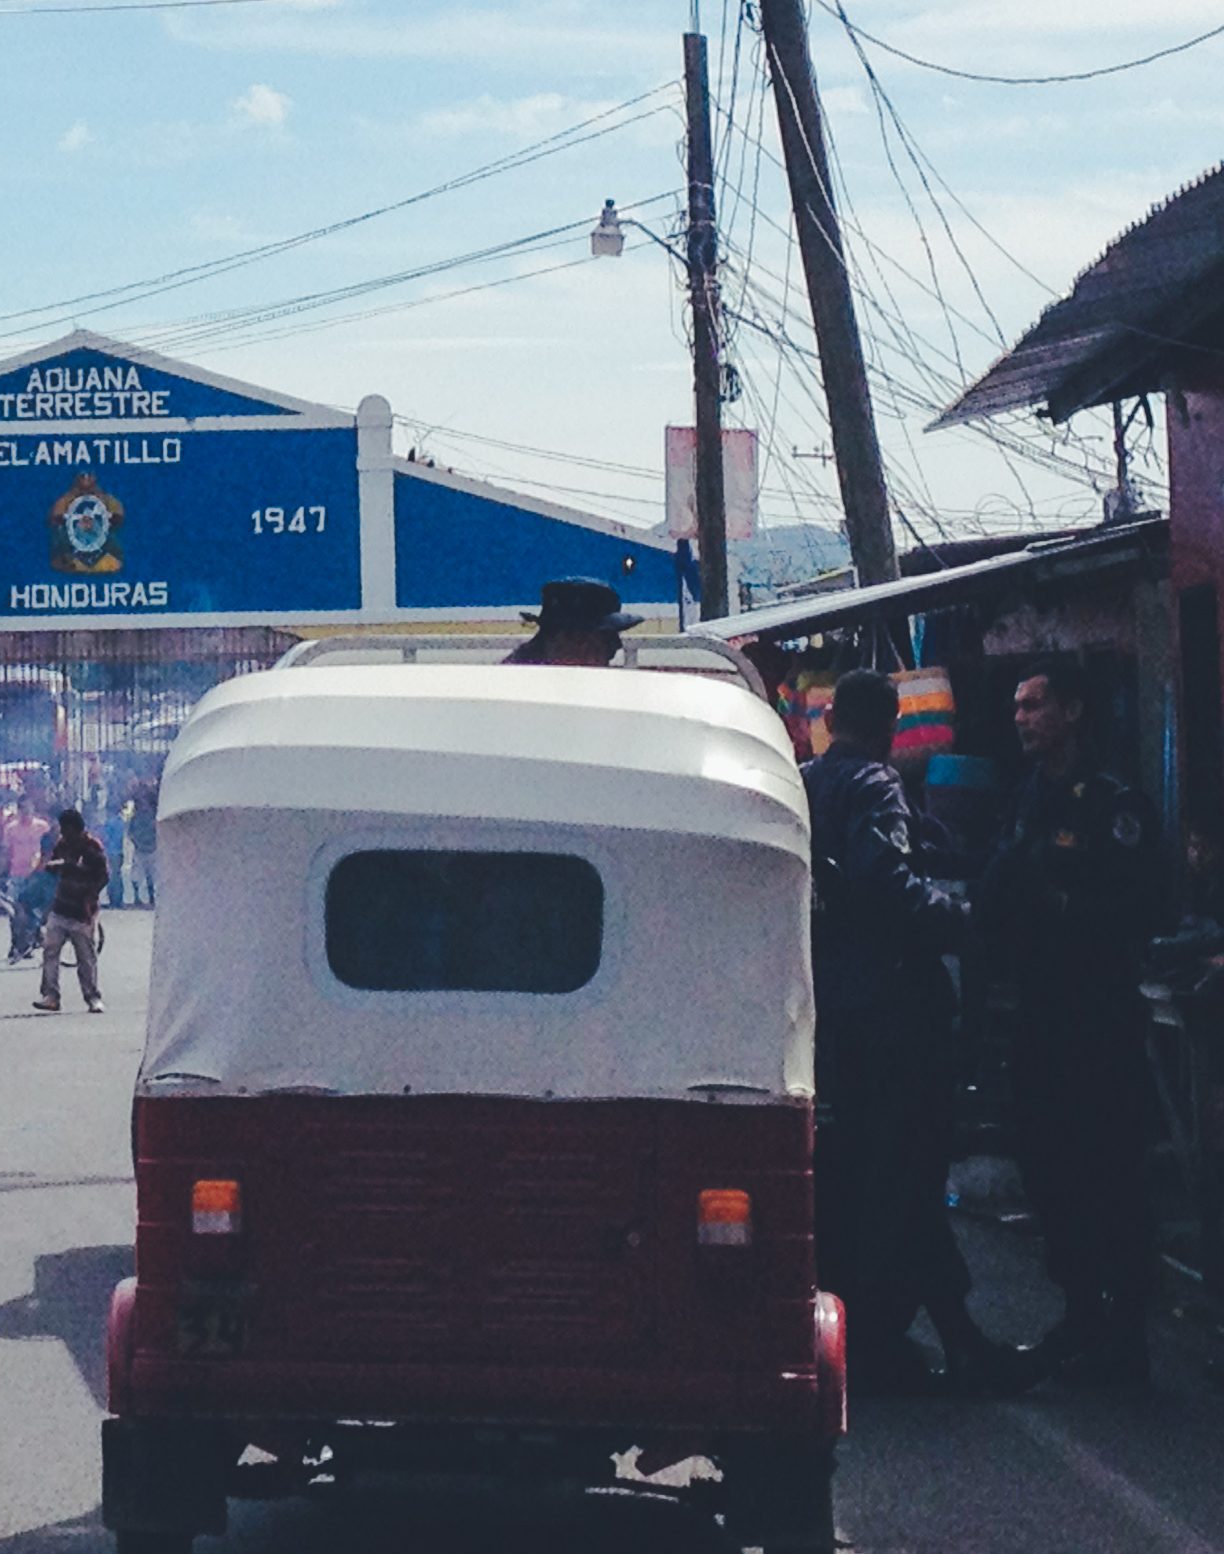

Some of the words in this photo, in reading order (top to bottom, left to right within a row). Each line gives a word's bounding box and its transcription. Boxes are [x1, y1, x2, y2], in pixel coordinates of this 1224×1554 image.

[26, 366, 143, 392] ADUANA
[34, 438, 181, 465] AMATILLO
[251, 506, 326, 534] 1947
[10, 581, 168, 608] HONDURAS
